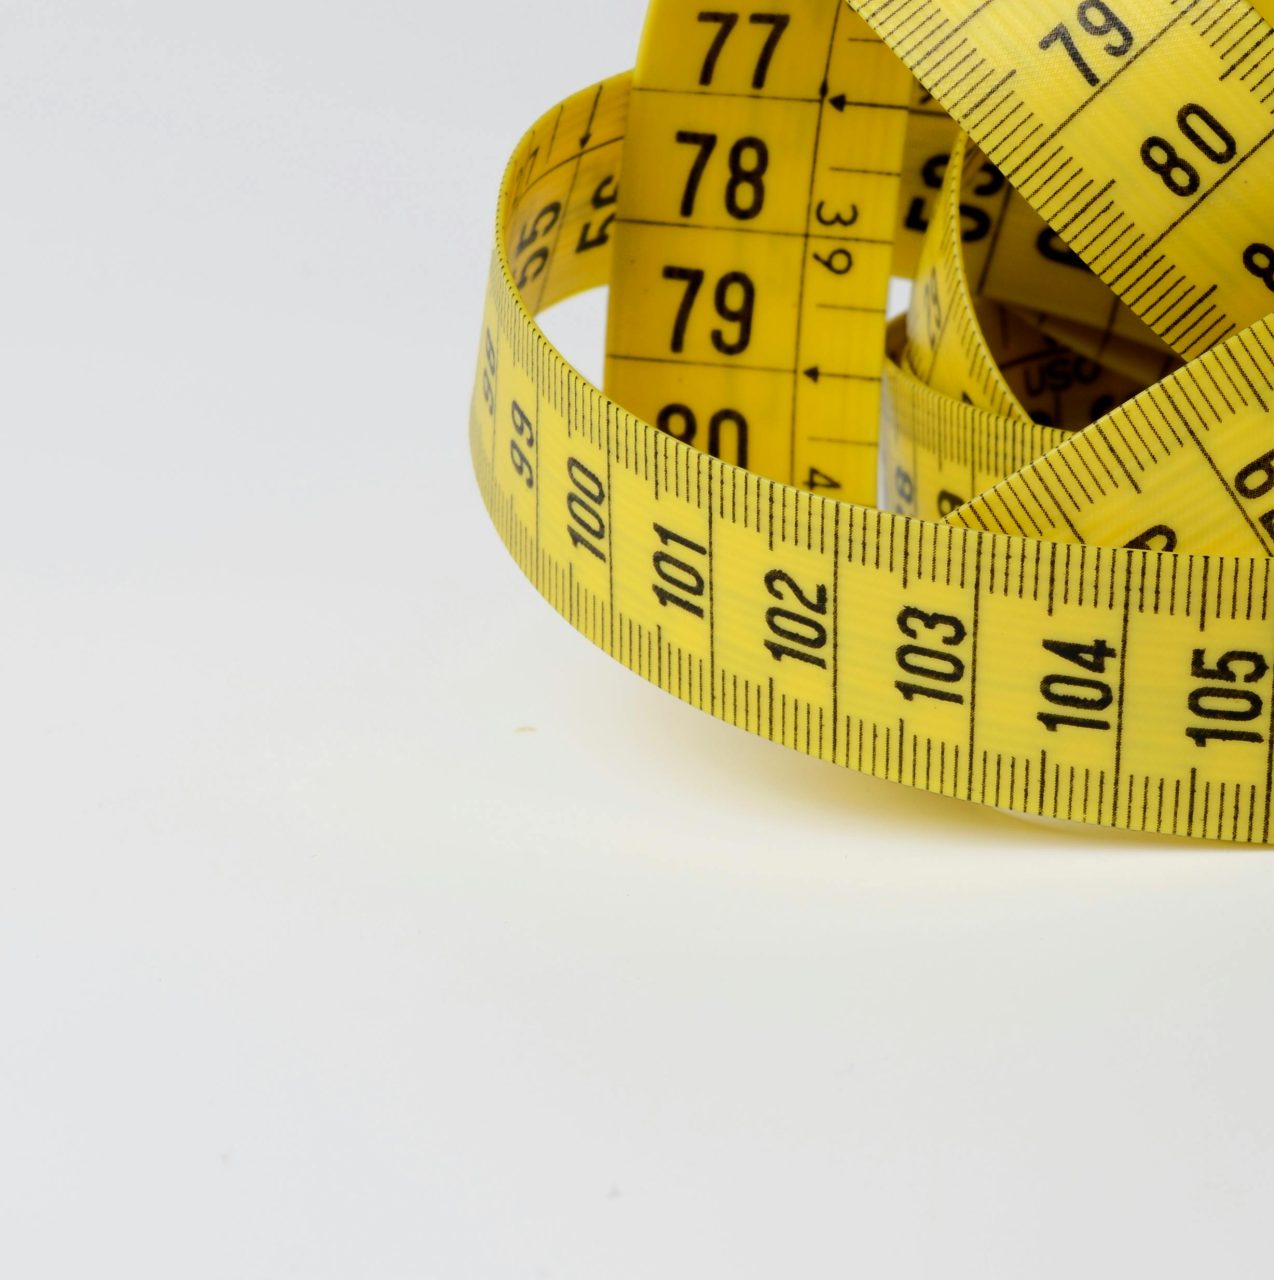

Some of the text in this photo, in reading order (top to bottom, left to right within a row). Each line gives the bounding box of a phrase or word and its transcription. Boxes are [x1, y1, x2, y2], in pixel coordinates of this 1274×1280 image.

[697, 11, 790, 90] 77
[675, 130, 768, 220] 78
[1140, 103, 1237, 197] 80
[812, 200, 859, 276] 39
[661, 265, 755, 355] 79
[510, 399, 535, 488] 99
[566, 456, 606, 563] 100
[652, 522, 708, 619] 101
[764, 568, 828, 670] 102
[894, 603, 967, 705] 103
[1036, 638, 1117, 732] 104
[1185, 648, 1270, 748] 105
